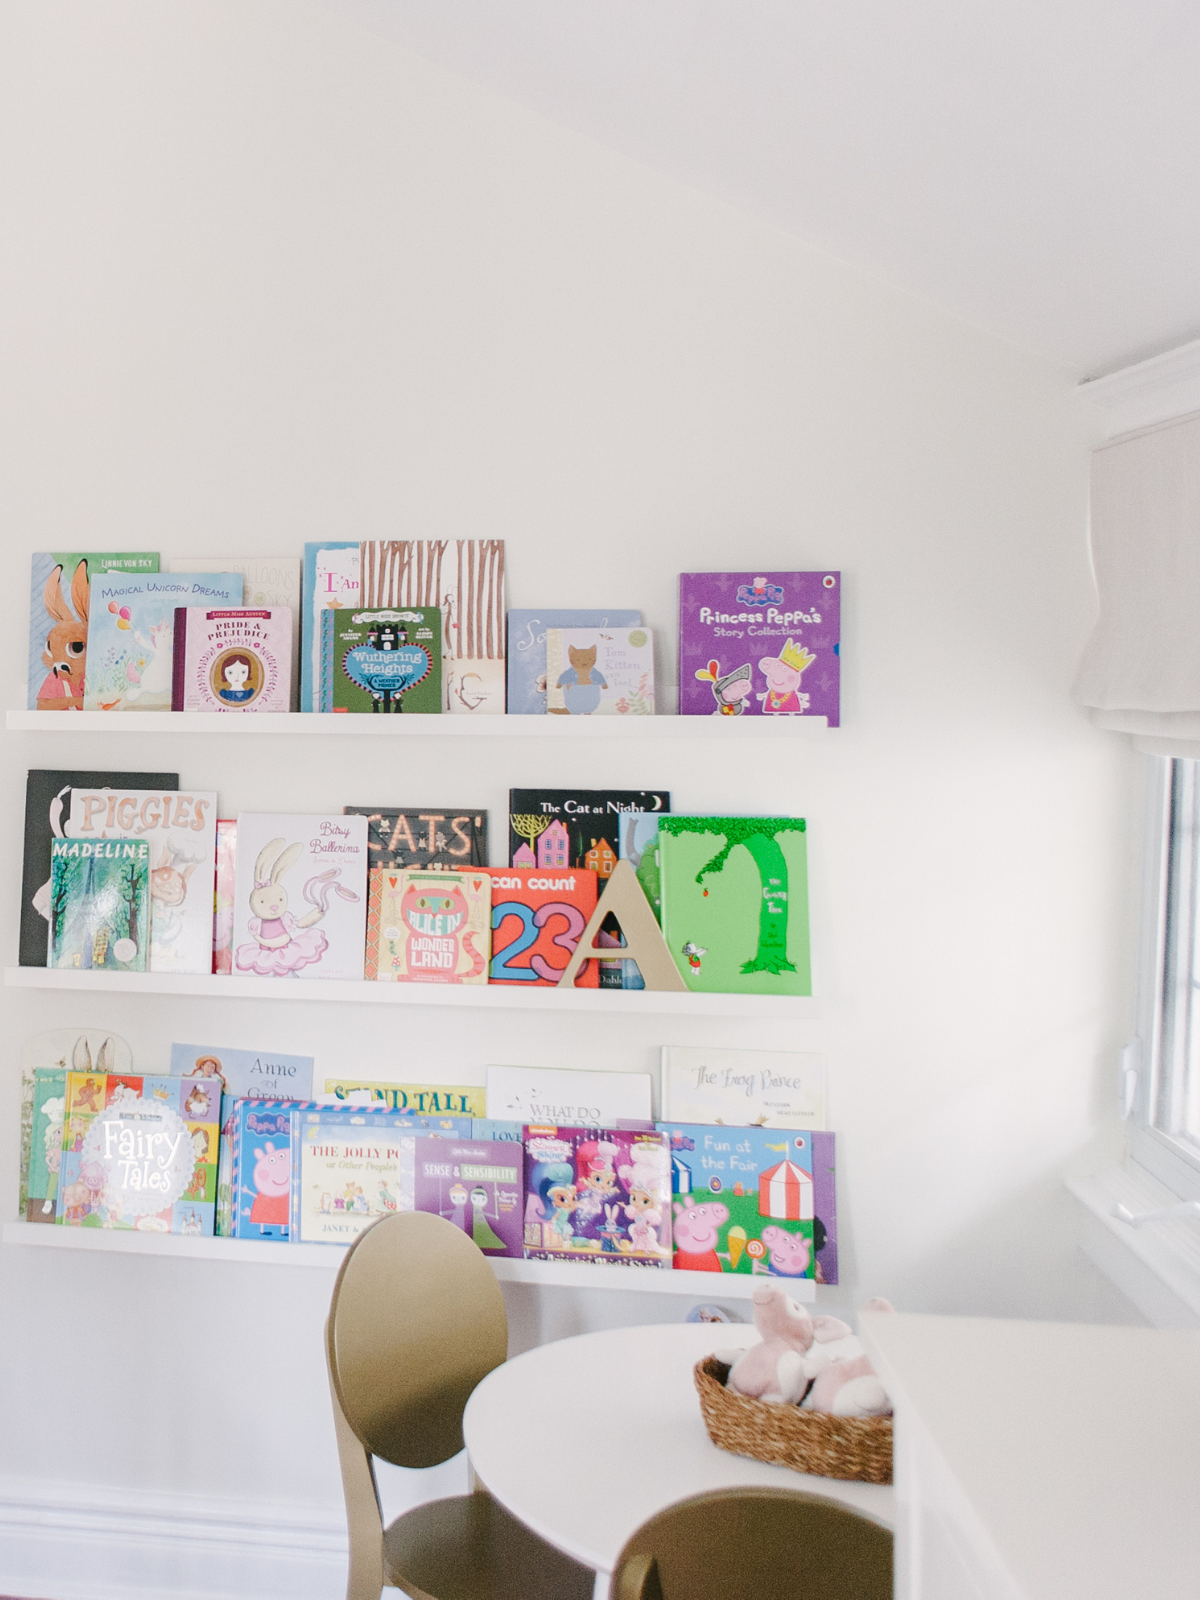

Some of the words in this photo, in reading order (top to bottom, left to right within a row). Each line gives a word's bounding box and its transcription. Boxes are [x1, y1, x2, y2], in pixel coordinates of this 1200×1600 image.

[323, 572, 338, 593] I
[101, 586, 144, 598] MAGICAL
[146, 583, 190, 593] UNICORN
[191, 584, 230, 598] DREAMS
[700, 607, 763, 625] Princess
[767, 607, 821, 626] Peppa's
[216, 622, 250, 631] PRIDE
[714, 627, 744, 638] Story
[747, 626, 802, 636] Collection
[207, 630, 270, 641] PREJUDICE
[352, 651, 422, 664] Wuthering
[604, 646, 626, 656] Tom
[361, 663, 413, 676] Heights
[604, 659, 640, 669] Kitten
[540, 802, 561, 813] The
[563, 800, 590, 814] Cat
[606, 801, 645, 814] Night
[80, 796, 210, 835] PIGGIES
[53, 843, 148, 859] MADELINE
[309, 838, 360, 854] Ballerina
[491, 876, 522, 889] can
[527, 875, 576, 890] count
[409, 910, 444, 935] ALICE
[410, 937, 455, 952] WONDER
[410, 951, 453, 968] LAND
[250, 1058, 297, 1077] Anne
[260, 1078, 279, 1089] of
[691, 1065, 717, 1090] The
[720, 1067, 755, 1098] Frog
[758, 1069, 802, 1090] Prince
[530, 1104, 574, 1118] WHAT
[577, 1107, 601, 1119] DO
[248, 1113, 276, 1134] Peppa
[277, 1116, 290, 1134] Pig
[102, 1120, 184, 1169] Fairy
[704, 1135, 731, 1151] Fun
[735, 1139, 751, 1153] at
[310, 1145, 338, 1157] THE
[343, 1147, 381, 1159] JOLLY
[338, 1161, 363, 1170] Other
[701, 1155, 726, 1170] the
[730, 1155, 757, 1171] Fair
[118, 1160, 171, 1193] Tales
[424, 1164, 450, 1176] SENSE
[453, 1166, 460, 1177] &
[463, 1166, 515, 1180] SENSIBILITY
[322, 1224, 350, 1232] JANET
